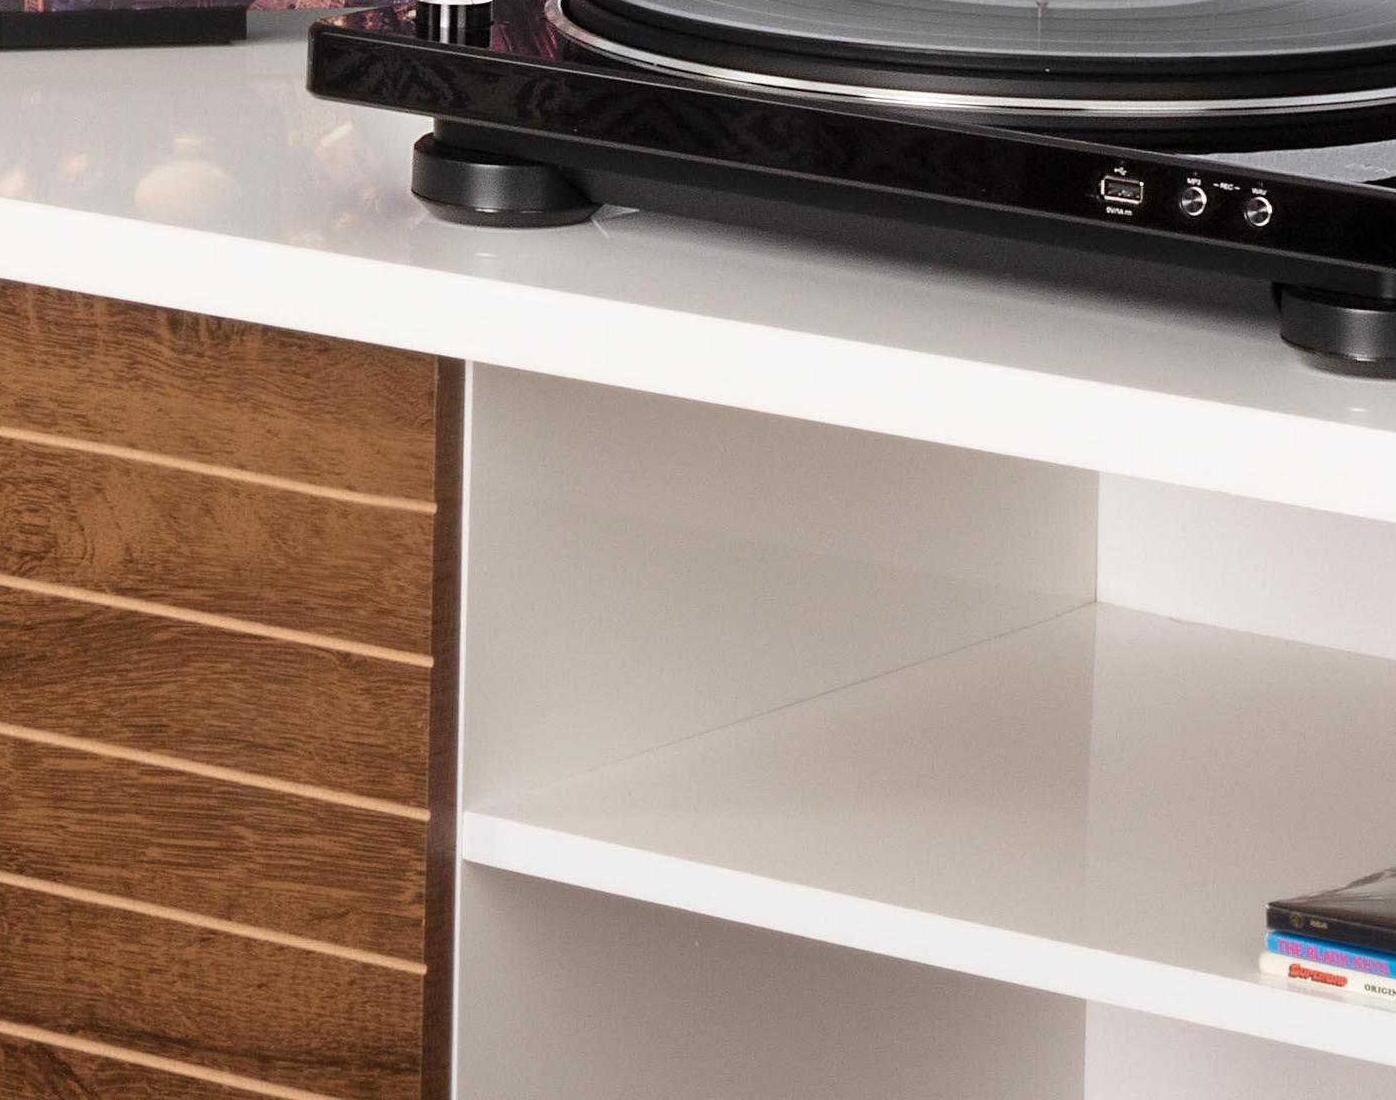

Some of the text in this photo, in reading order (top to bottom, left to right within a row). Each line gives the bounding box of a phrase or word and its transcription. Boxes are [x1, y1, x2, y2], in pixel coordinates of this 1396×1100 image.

[1277, 938, 1391, 977] THE BLACK KEYS
